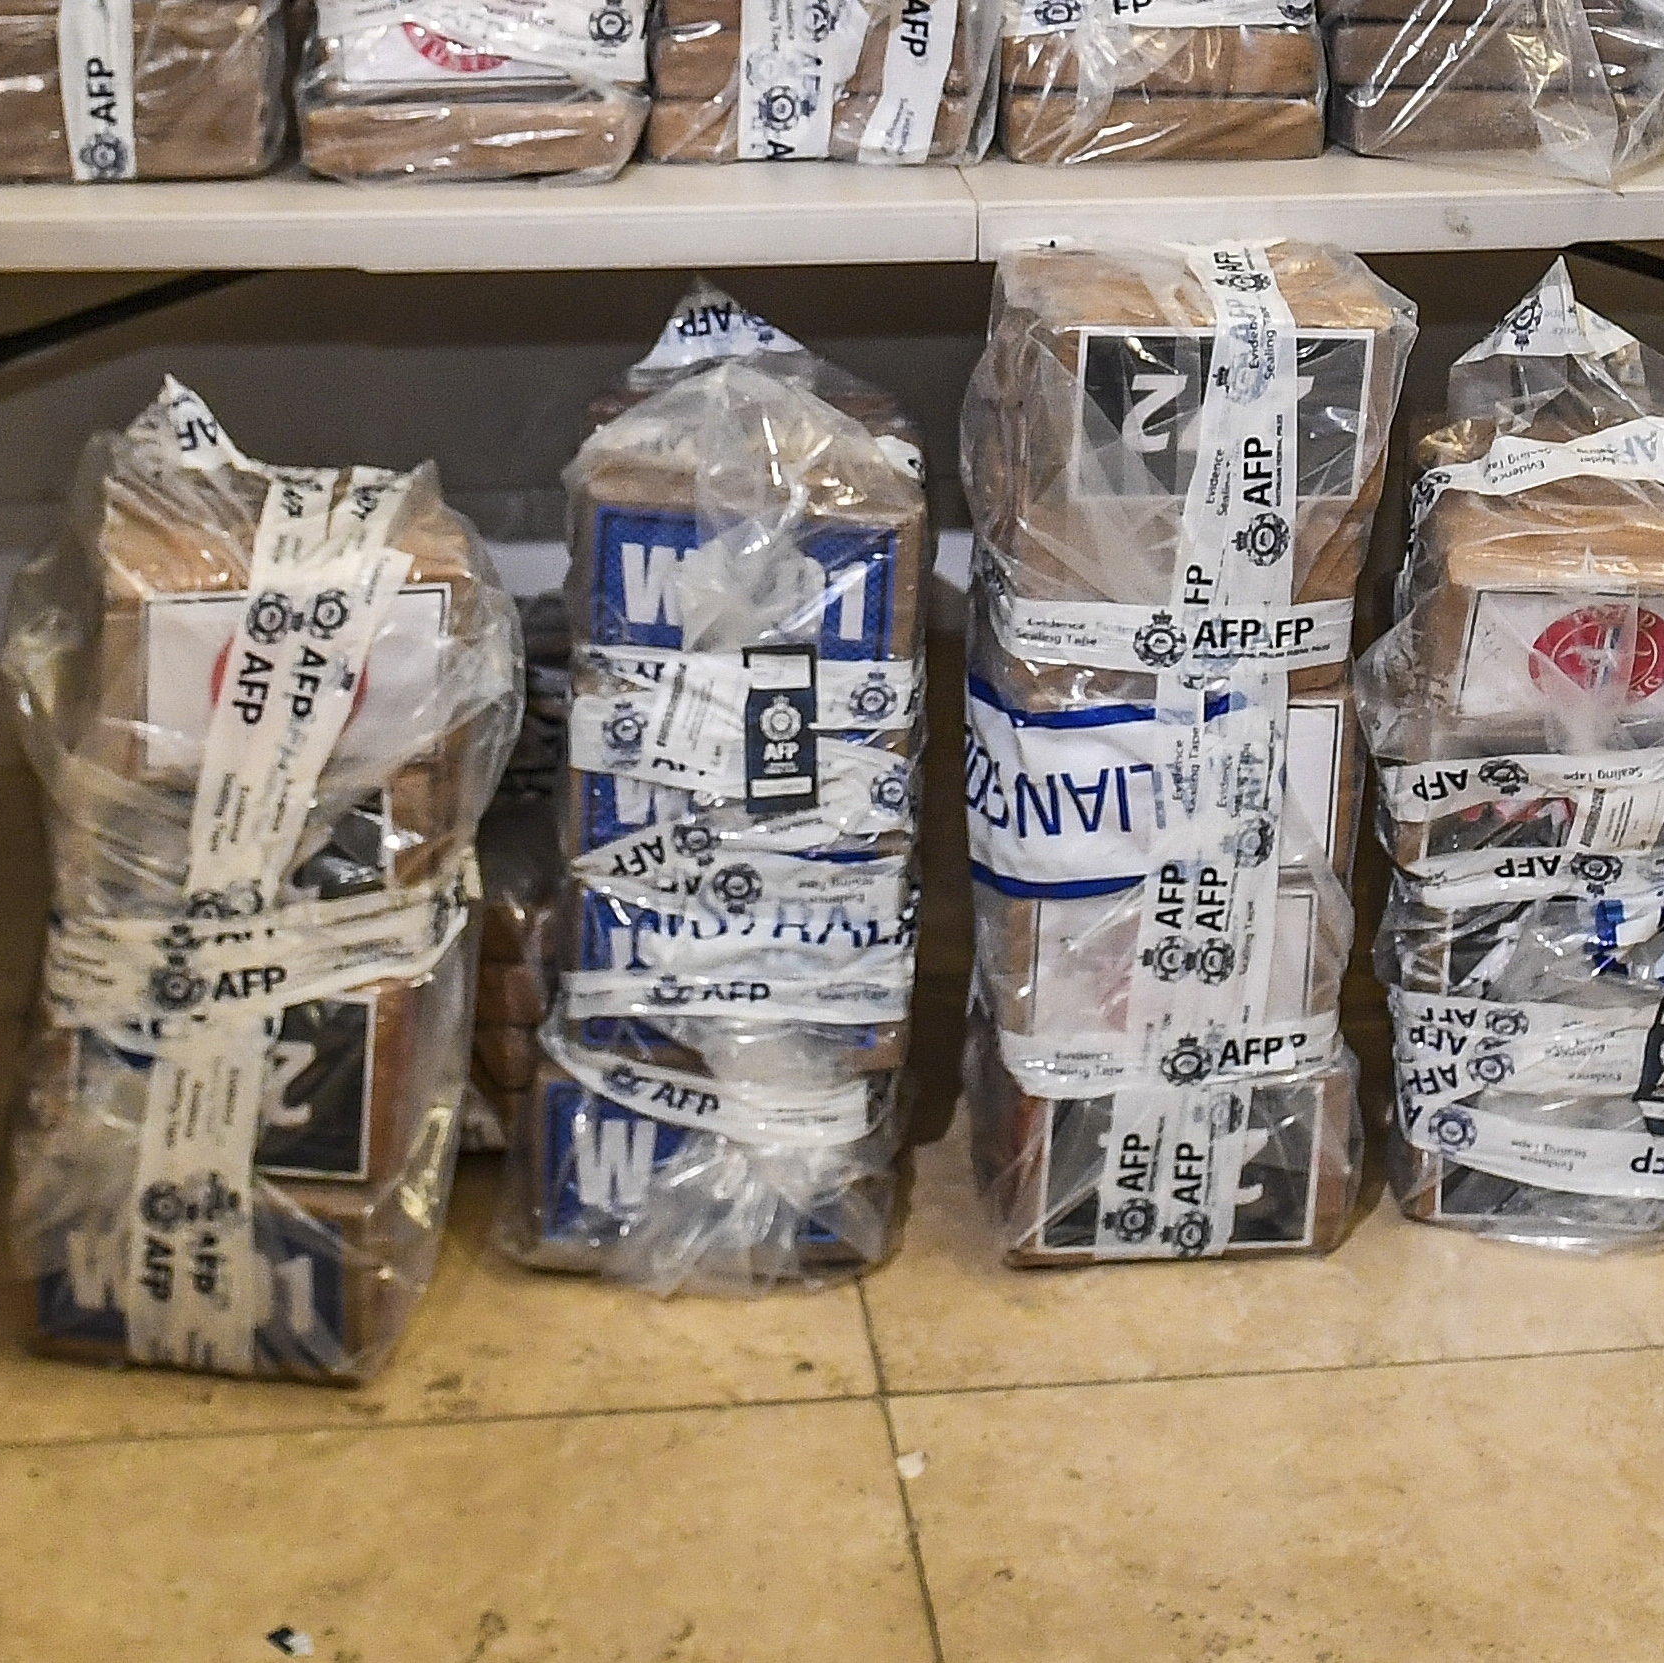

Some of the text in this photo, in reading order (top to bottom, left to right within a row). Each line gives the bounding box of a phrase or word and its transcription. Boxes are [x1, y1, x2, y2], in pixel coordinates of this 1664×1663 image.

[86, 56, 117, 126] AFP
[1206, 448, 1225, 504] Evidence
[1243, 435, 1274, 508] AFP
[1183, 564, 1213, 605] FP
[1192, 618, 1261, 650] AFP
[232, 650, 275, 726] AFP
[290, 645, 328, 719] AFP
[764, 740, 800, 762] AFP
[1412, 767, 1469, 802] AFP
[1494, 853, 1562, 879] AFP
[1155, 861, 1190, 929] AFP
[1195, 866, 1229, 933] AFP
[212, 967, 288, 1002] AFP
[1218, 1036, 1285, 1070] AFP
[652, 1082, 720, 1116] AFP
[1116, 1132, 1152, 1193] AFP
[1173, 1139, 1208, 1206] AFP
